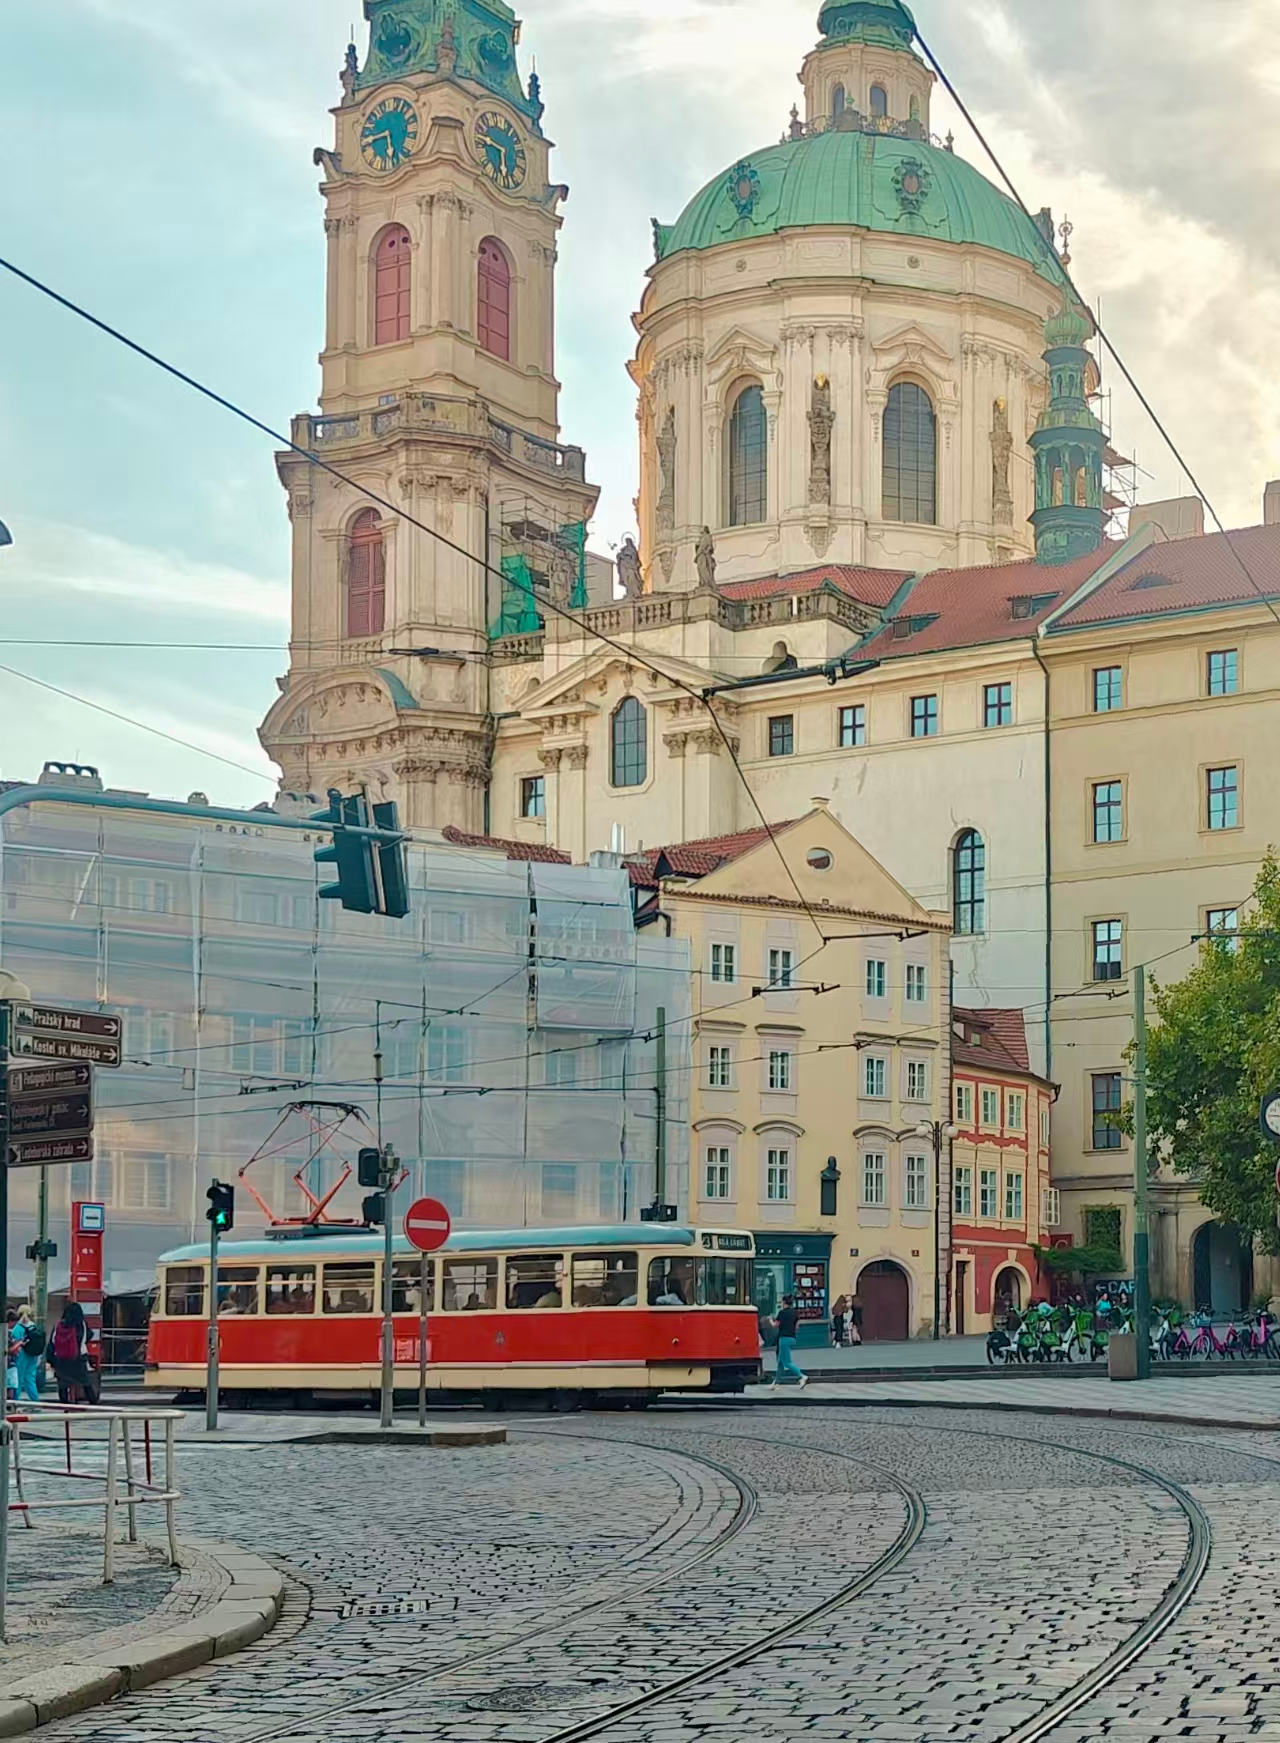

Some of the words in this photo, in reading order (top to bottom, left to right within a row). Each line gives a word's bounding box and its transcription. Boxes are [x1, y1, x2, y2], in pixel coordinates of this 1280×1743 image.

[34, 1010, 61, 1028] Pražský
[65, 1016, 81, 1029] hrad
[34, 1040, 56, 1054] Kostel
[58, 1045, 68, 1056] sv.
[70, 1042, 100, 1059] Mikuláše
[1107, 1280, 1136, 1293] CAF
